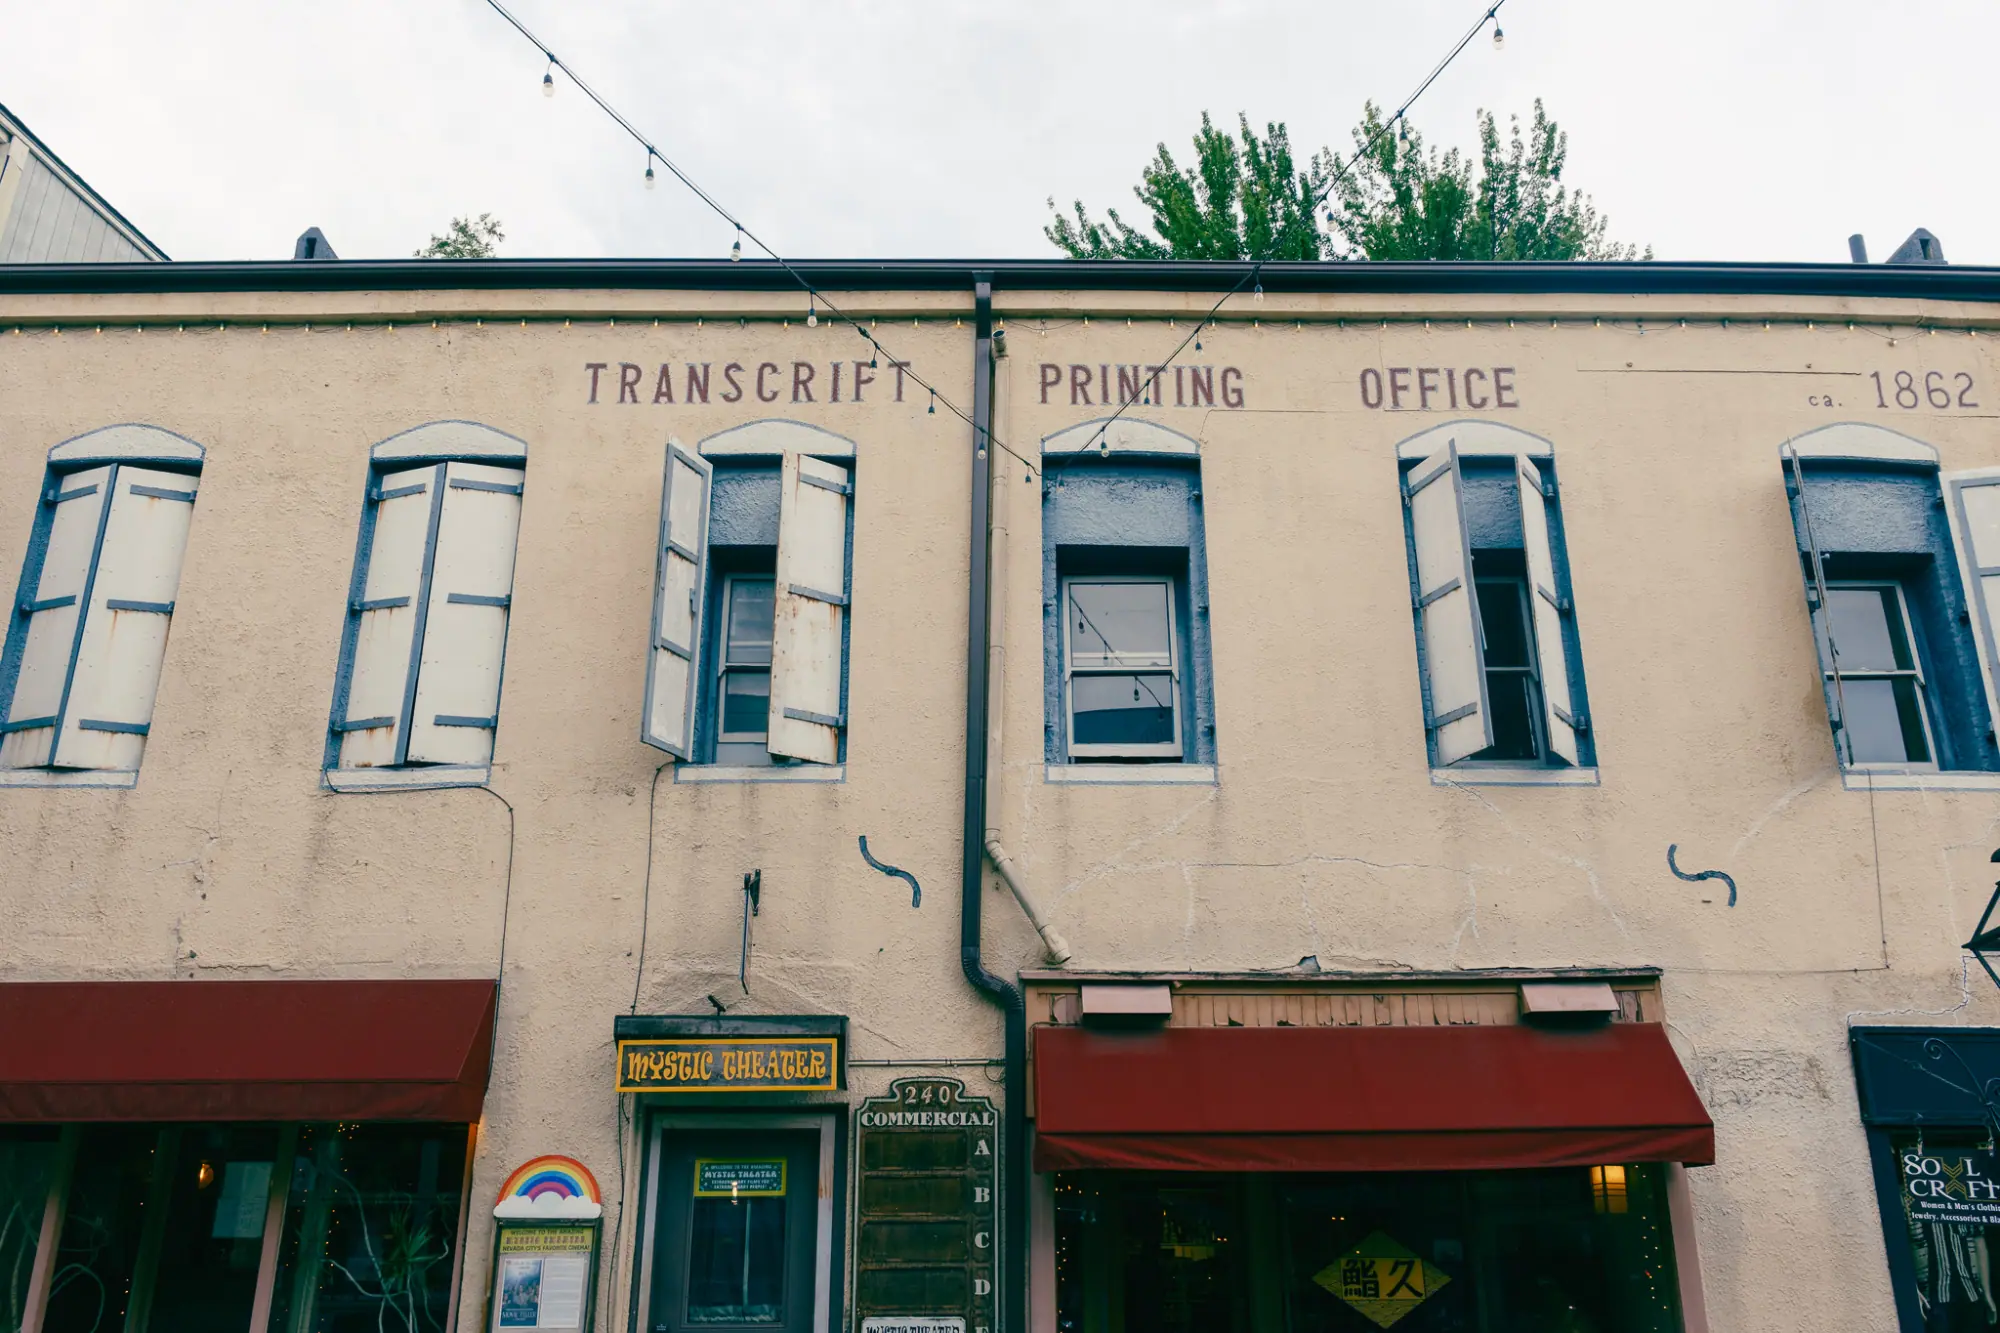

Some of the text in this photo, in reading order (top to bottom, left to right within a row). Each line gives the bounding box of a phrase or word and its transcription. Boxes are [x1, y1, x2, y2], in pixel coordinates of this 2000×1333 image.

[584, 360, 1519, 409] TRANSCRIPT PRINTING OFFICE
[1808, 370, 1980, 409] ca. 1862
[627, 1049, 826, 1082] MYSTIC THEATER
[904, 1085, 951, 1105] 240
[860, 1111, 994, 1127] COMMERCIAL
[974, 1139, 991, 1155] A
[974, 1187, 991, 1203] B
[1920, 1201, 1946, 1209] Women
[1947, 1202, 1953, 1210] &
[1954, 1203, 1976, 1211] Men's
[1940, 1213, 1981, 1222] Accessories
[974, 1232, 990, 1248] C
[974, 1279, 991, 1295] D
